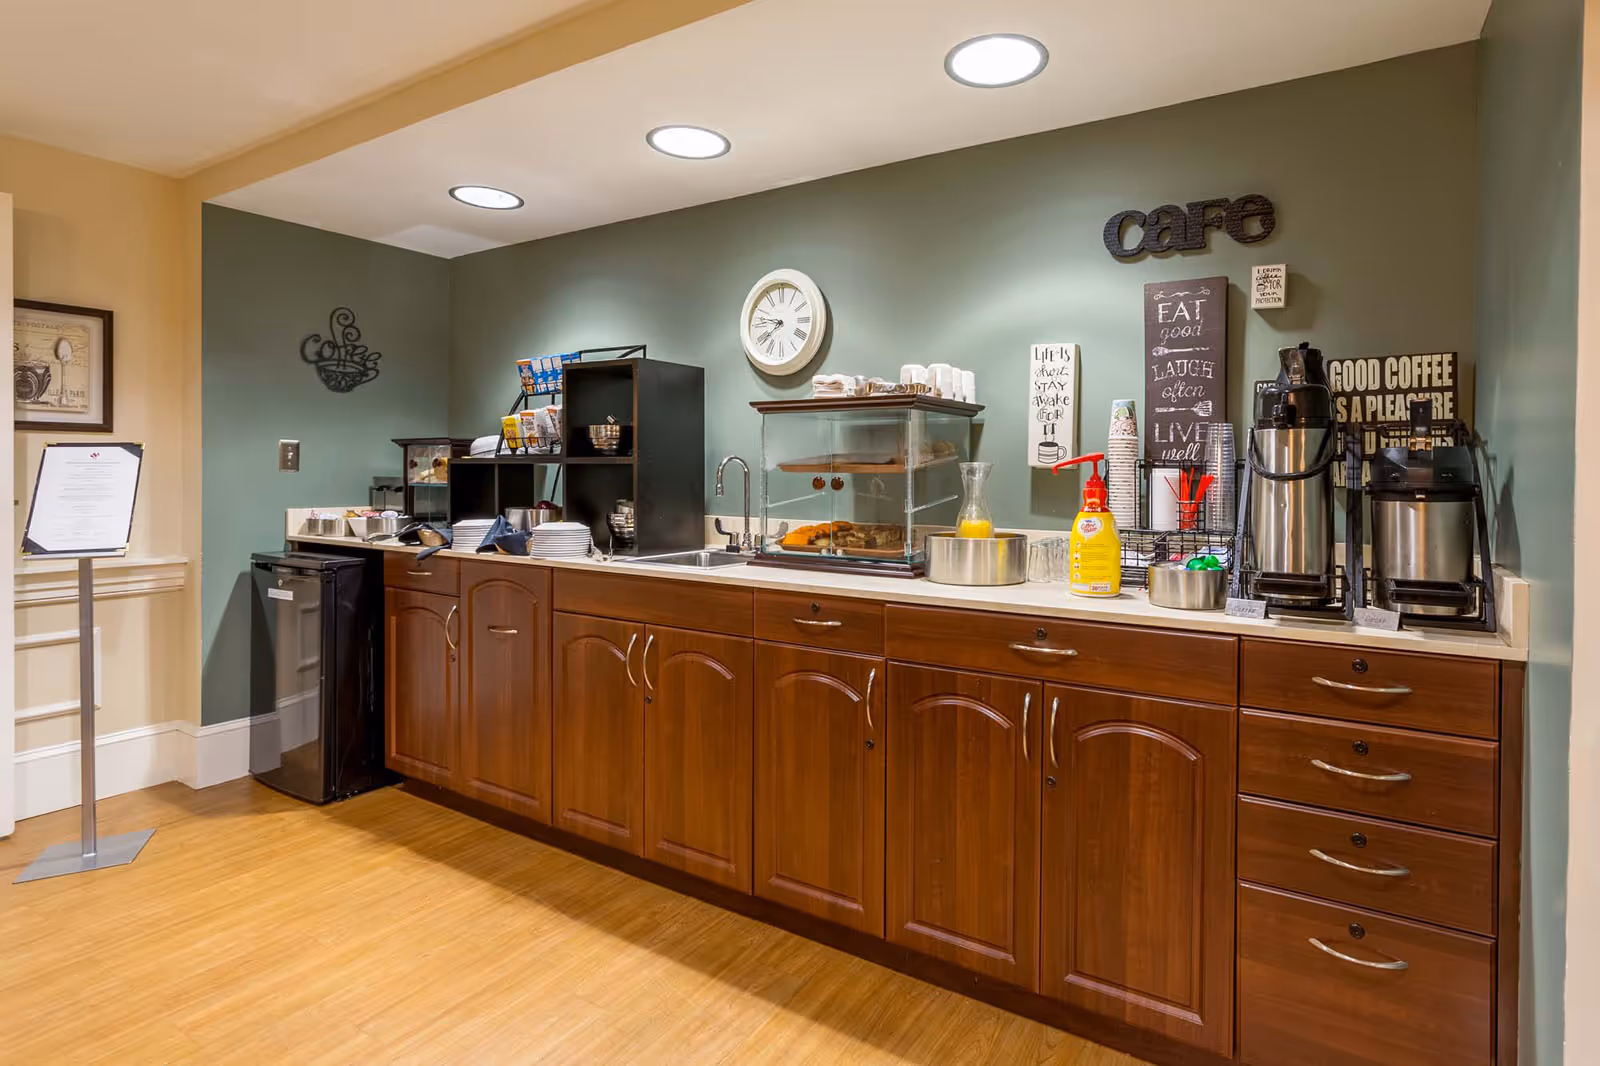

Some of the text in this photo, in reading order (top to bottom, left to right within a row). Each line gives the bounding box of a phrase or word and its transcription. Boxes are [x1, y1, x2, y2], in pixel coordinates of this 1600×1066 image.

[1157, 299, 1206, 323] EAT
[1160, 321, 1204, 345] good
[1152, 359, 1215, 381] LAUGH
[1330, 353, 1453, 392] GOOD COFFEE
[1034, 380, 1068, 392] STAY
[1161, 381, 1205, 402] often
[1032, 393, 1071, 407] awake
[1335, 391, 1453, 422] S A PLEASRE
[1040, 407, 1063, 421] FOR
[1043, 422, 1057, 435] IT
[1153, 421, 1209, 442] LIVE
[1161, 442, 1201, 460] well
